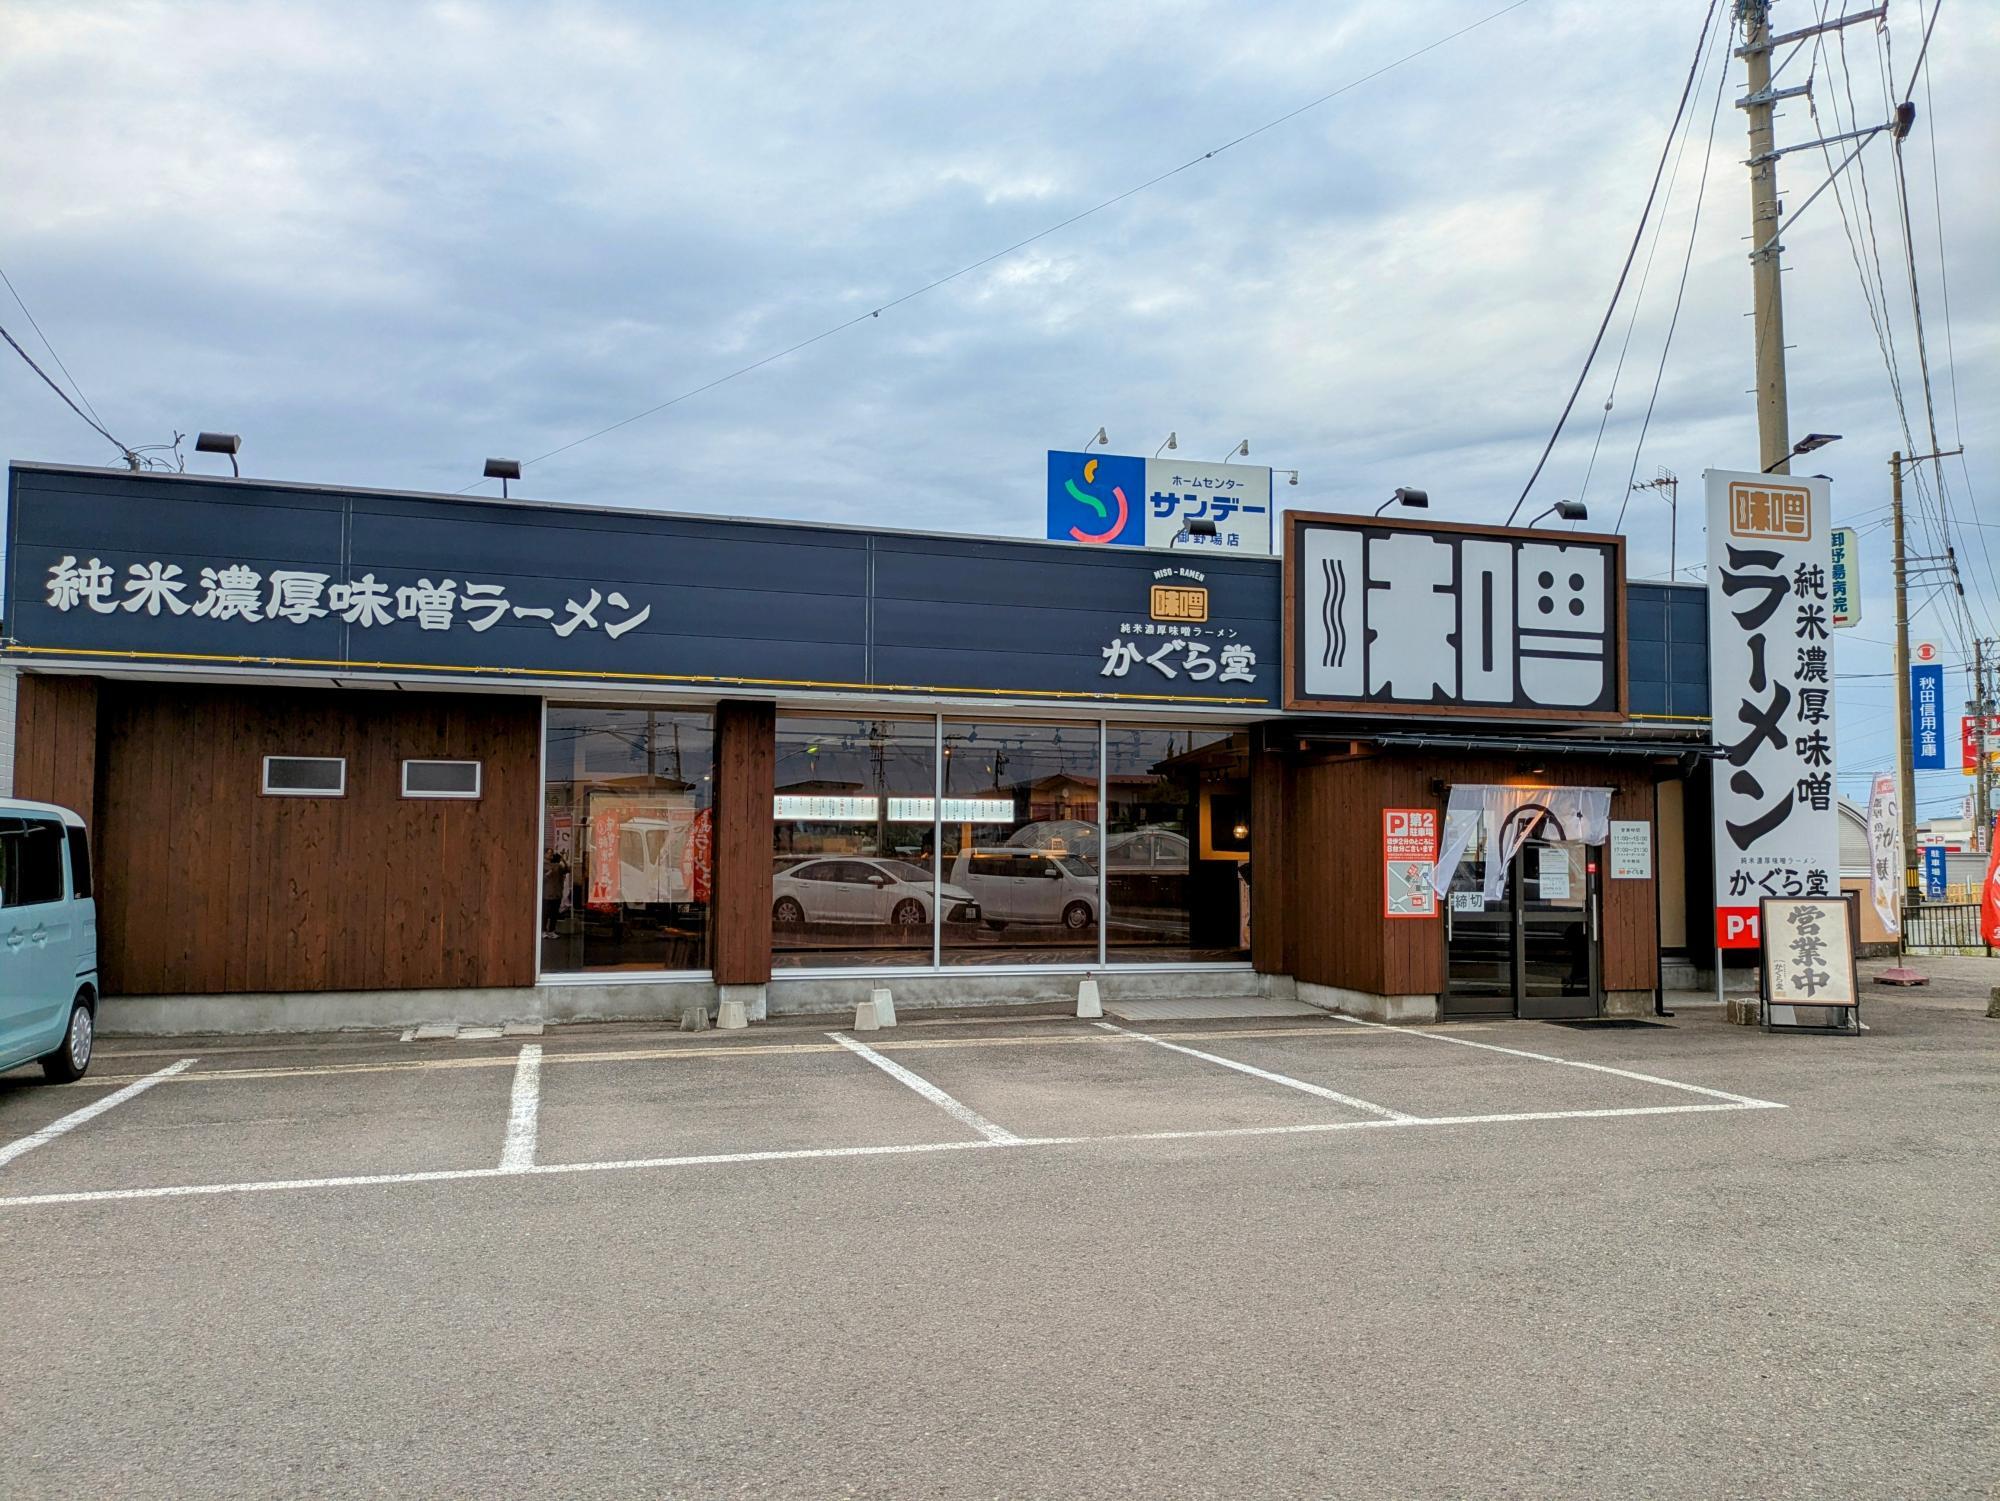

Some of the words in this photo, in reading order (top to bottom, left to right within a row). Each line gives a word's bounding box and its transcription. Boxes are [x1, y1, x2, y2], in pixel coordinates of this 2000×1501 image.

[1172, 476, 1244, 489] ホームセンター
[1150, 492, 1265, 521] サンデー
[1153, 567, 1173, 580] MISO
[1180, 567, 1205, 582] RAMEN
[45, 555, 652, 641] 純米濃厚味噌ラーメン
[1120, 623, 1238, 638] 純米濃厚味噌ラーメン
[1100, 638, 1257, 683] かぐら堂
[1718, 542, 1795, 851] ラーメン
[1793, 562, 1832, 811] 純米濃厚味噌
[1919, 677, 1937, 757] 秋田信用金庫
[1390, 815, 1404, 833] P
[1729, 868, 1829, 897] かぐら堂
[1455, 894, 1483, 909] 締切
[1787, 905, 1831, 998] 営業中
